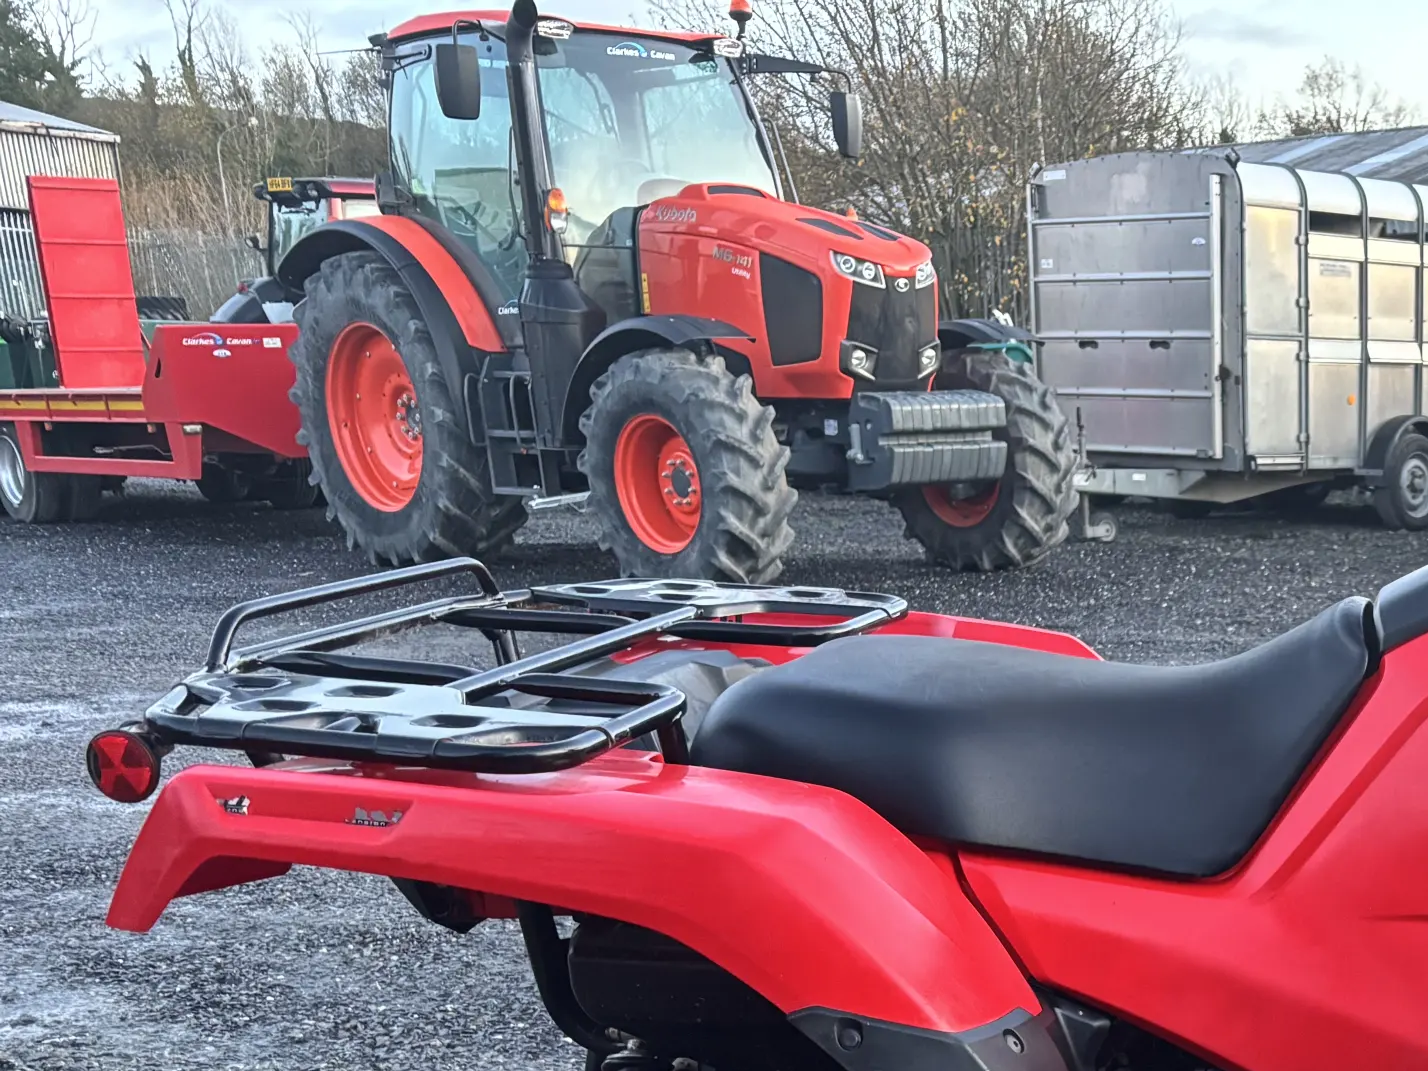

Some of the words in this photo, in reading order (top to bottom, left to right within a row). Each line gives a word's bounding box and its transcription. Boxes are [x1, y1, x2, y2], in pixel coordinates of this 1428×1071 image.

[606, 46, 639, 57] Clarkes
[650, 50, 676, 61] Cavan
[656, 205, 697, 222] Kubota
[182, 337, 214, 346] Clarkes
[226, 337, 252, 345] Cavan
